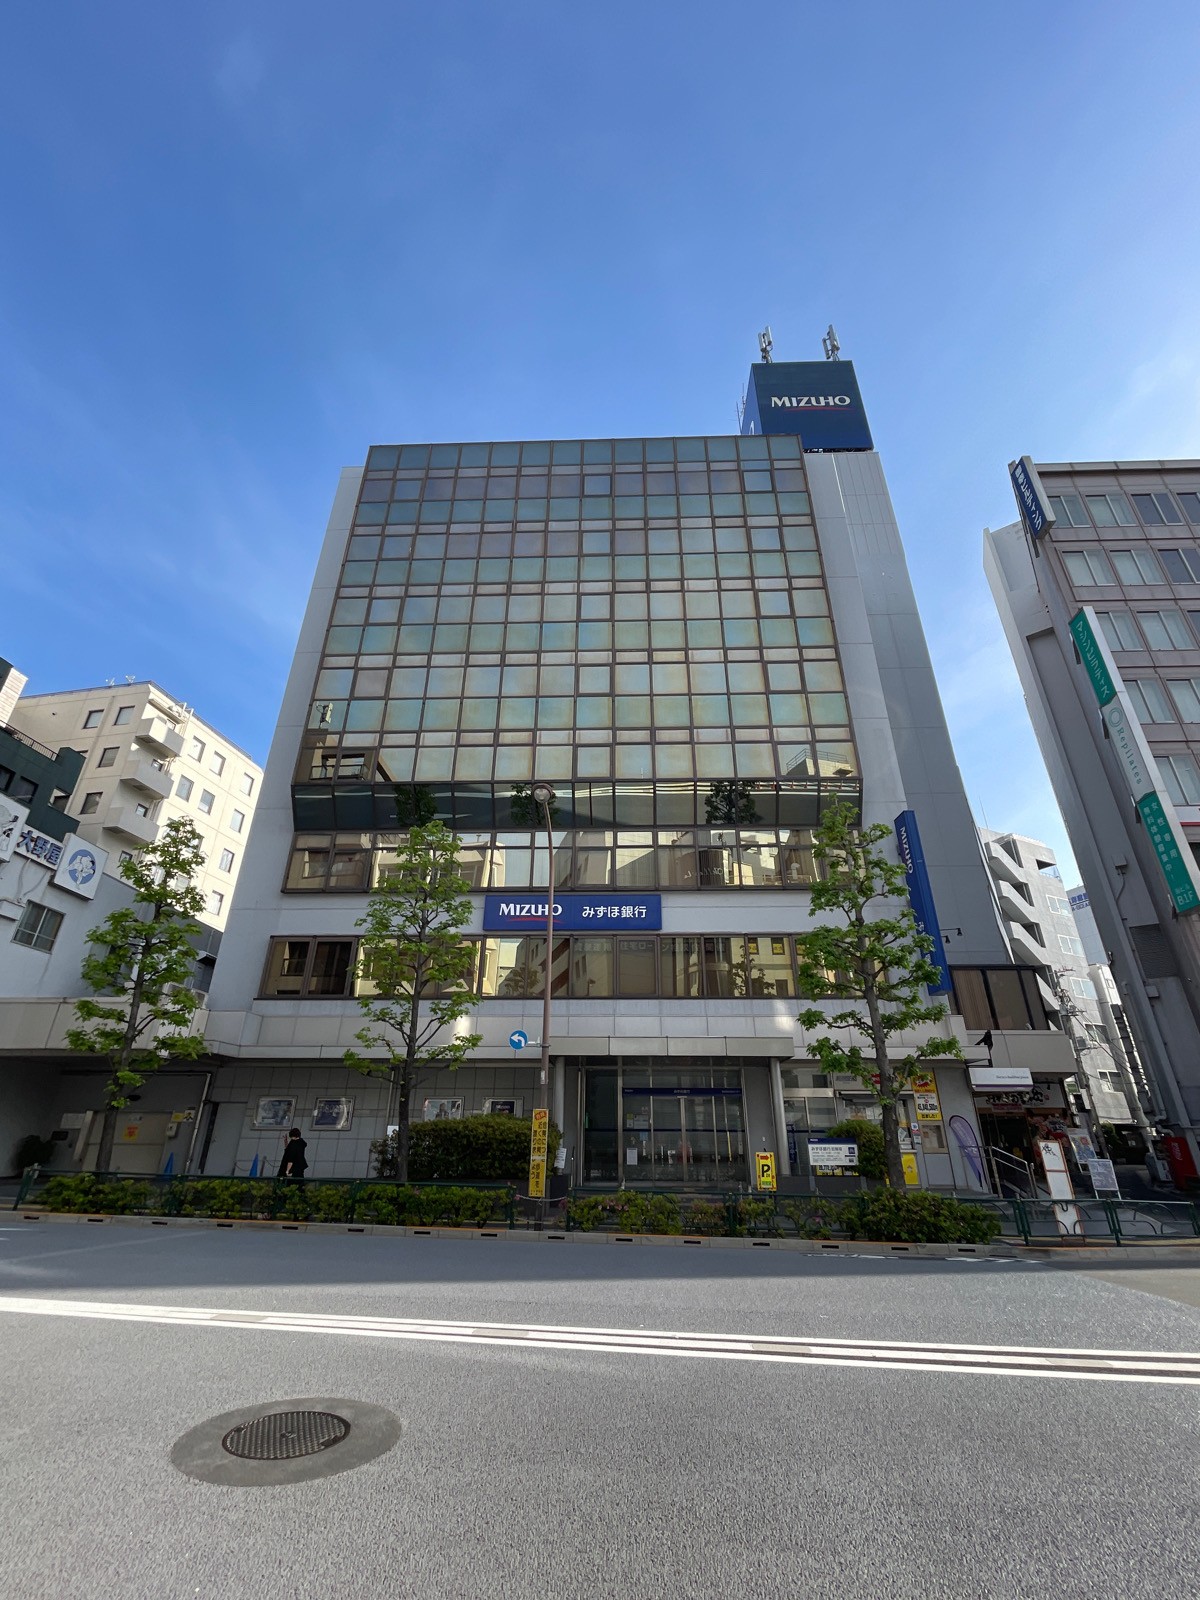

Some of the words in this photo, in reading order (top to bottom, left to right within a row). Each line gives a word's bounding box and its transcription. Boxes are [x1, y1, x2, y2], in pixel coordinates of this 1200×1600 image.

[771, 395, 851, 408] MIZUHO
[1117, 727, 1142, 785] Repilates
[16, 829, 63, 866] 大野屋
[899, 826, 913, 874] MIZUHO
[1177, 890, 1194, 905] B1F
[499, 903, 563, 916] MIZUHO
[582, 905, 647, 918] みずほ銀行
[761, 1164, 771, 1178] P
